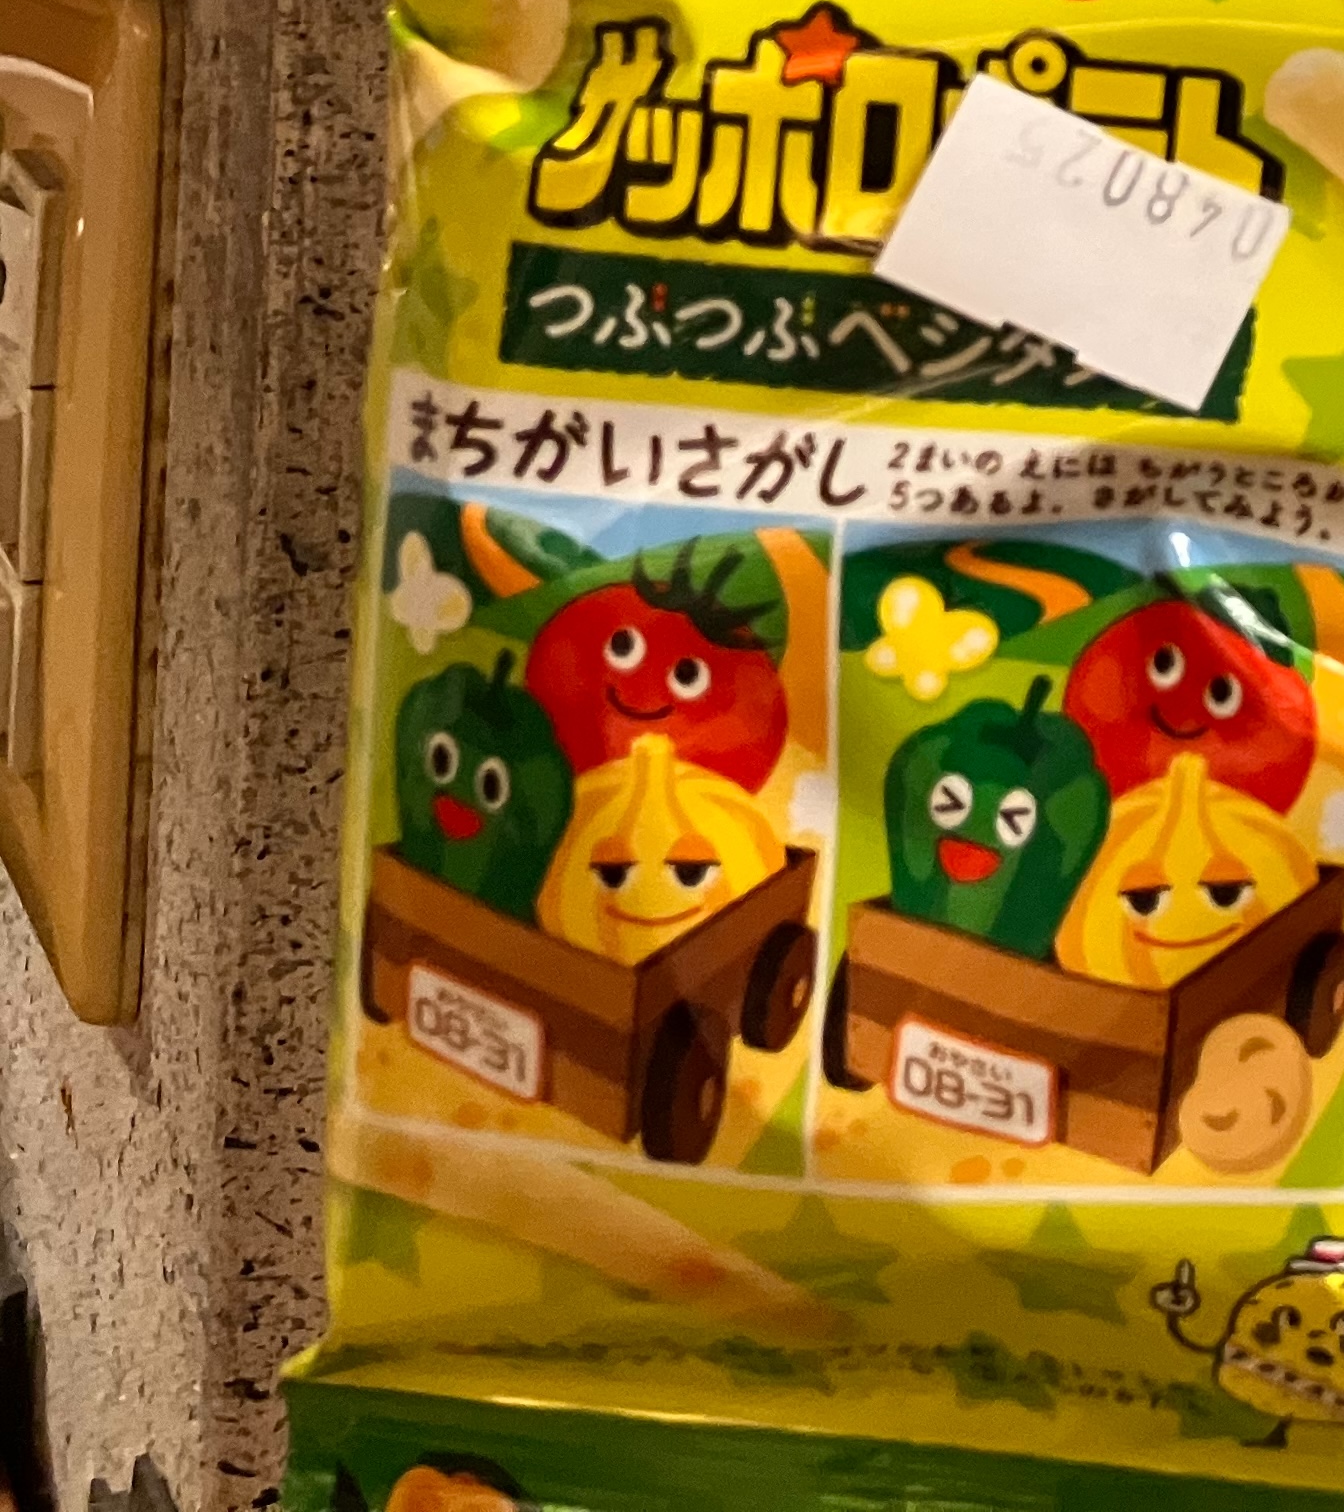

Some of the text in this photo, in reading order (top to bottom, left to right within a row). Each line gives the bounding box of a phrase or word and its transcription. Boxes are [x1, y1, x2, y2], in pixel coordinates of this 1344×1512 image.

[530, 281, 1110, 389] つぶつぶベジタ
[414, 997, 527, 1084] 08-31
[902, 1057, 1038, 1126] 08-31
